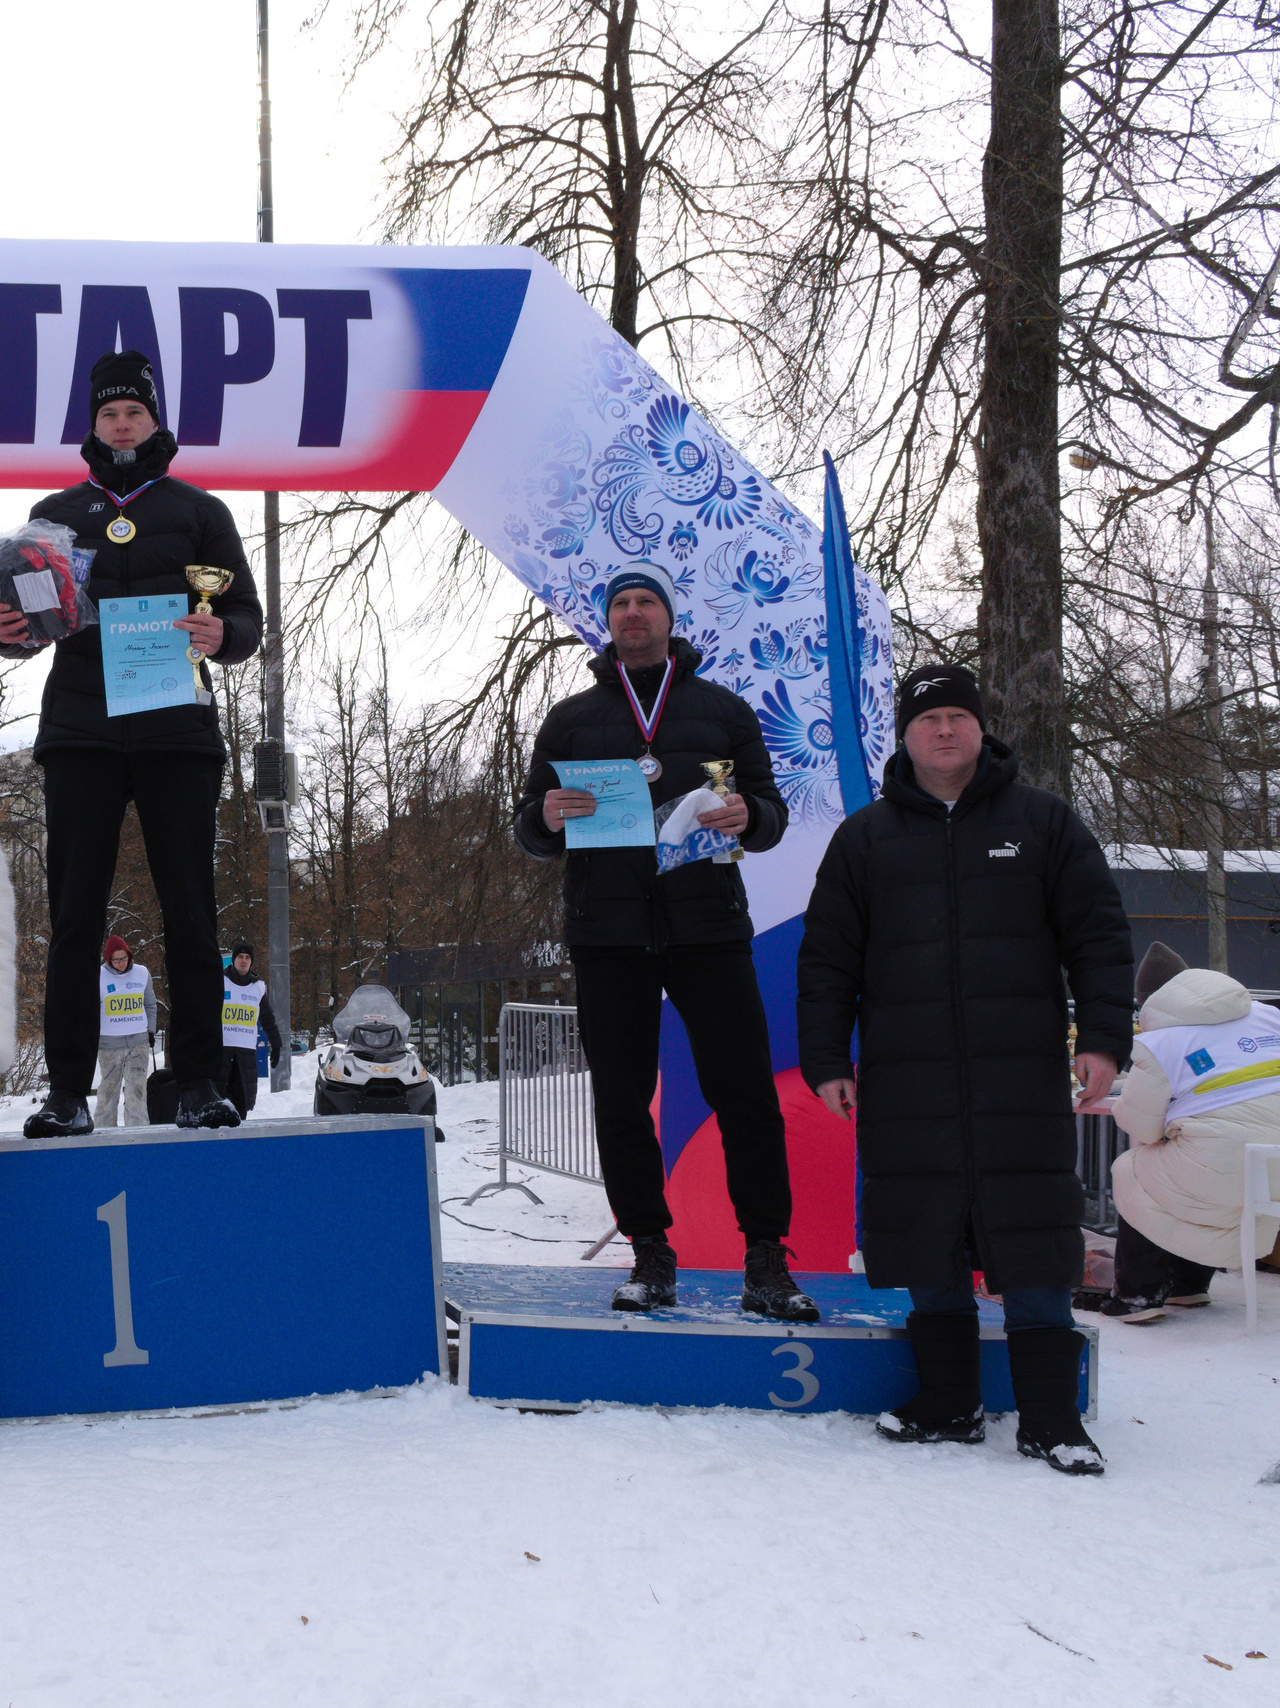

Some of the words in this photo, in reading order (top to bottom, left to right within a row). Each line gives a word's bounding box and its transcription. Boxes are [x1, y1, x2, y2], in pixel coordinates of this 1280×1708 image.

[97, 385, 140, 400] USPA
[564, 764, 632, 777] ГРАМОТА
[988, 848, 1016, 858] PUMA
[110, 997, 143, 1012] СУДЬЯ
[224, 1007, 255, 1022] СУДЬЯ
[96, 1190, 150, 1368] 1
[767, 1341, 820, 1409] 3
